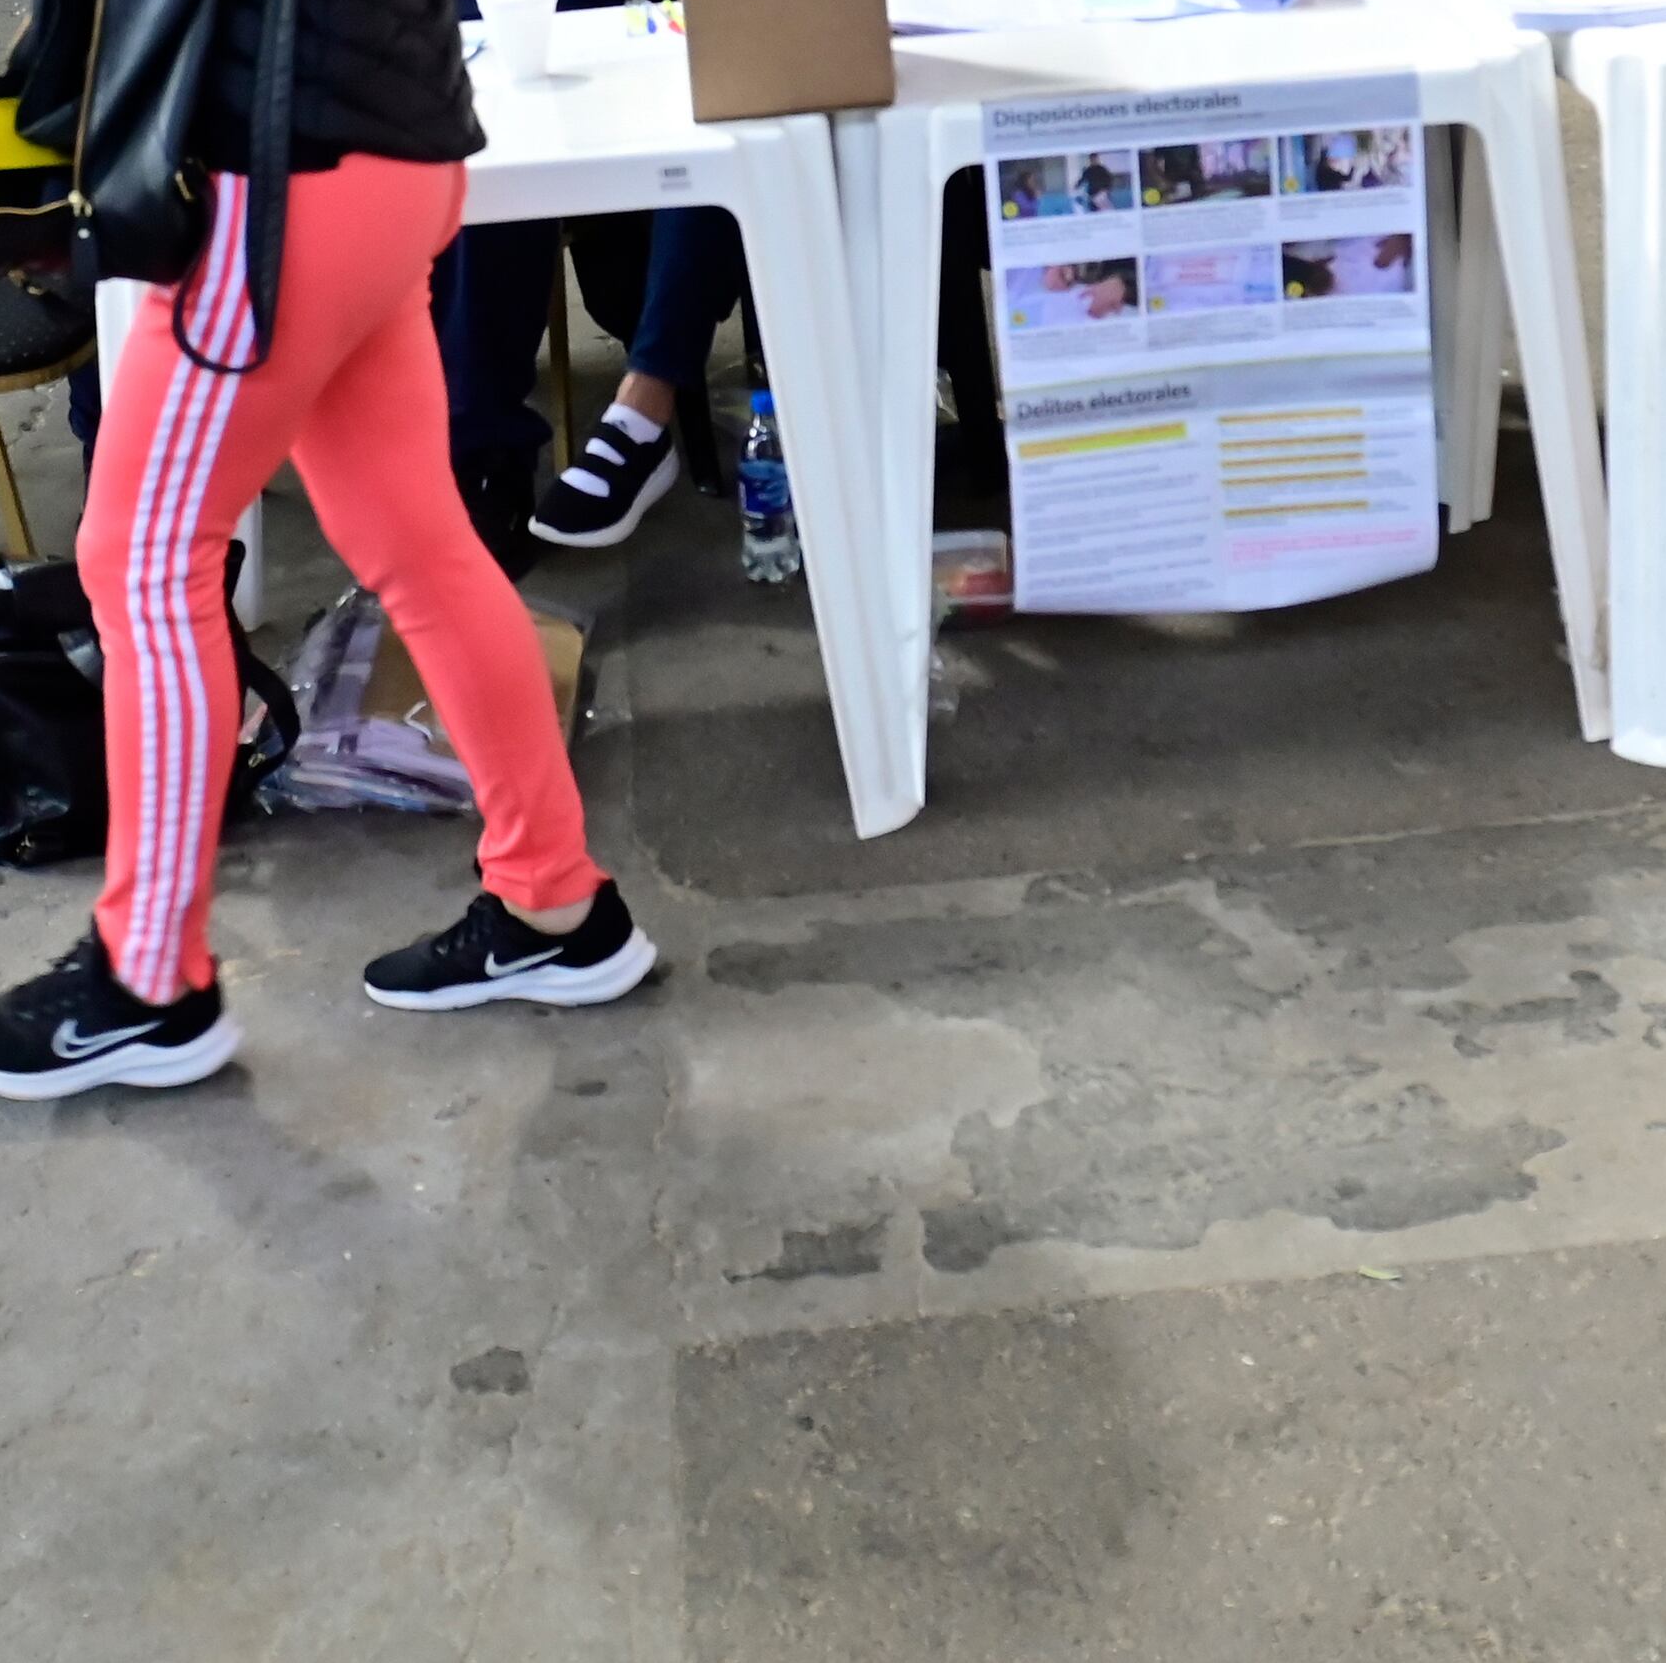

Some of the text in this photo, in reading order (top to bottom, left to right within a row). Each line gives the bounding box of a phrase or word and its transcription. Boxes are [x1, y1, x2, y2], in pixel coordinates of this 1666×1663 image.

[993, 101, 1129, 132] Disposiciones
[1134, 92, 1242, 116] electorales
[1017, 397, 1085, 420] Delitos
[1090, 383, 1192, 409] electorales
